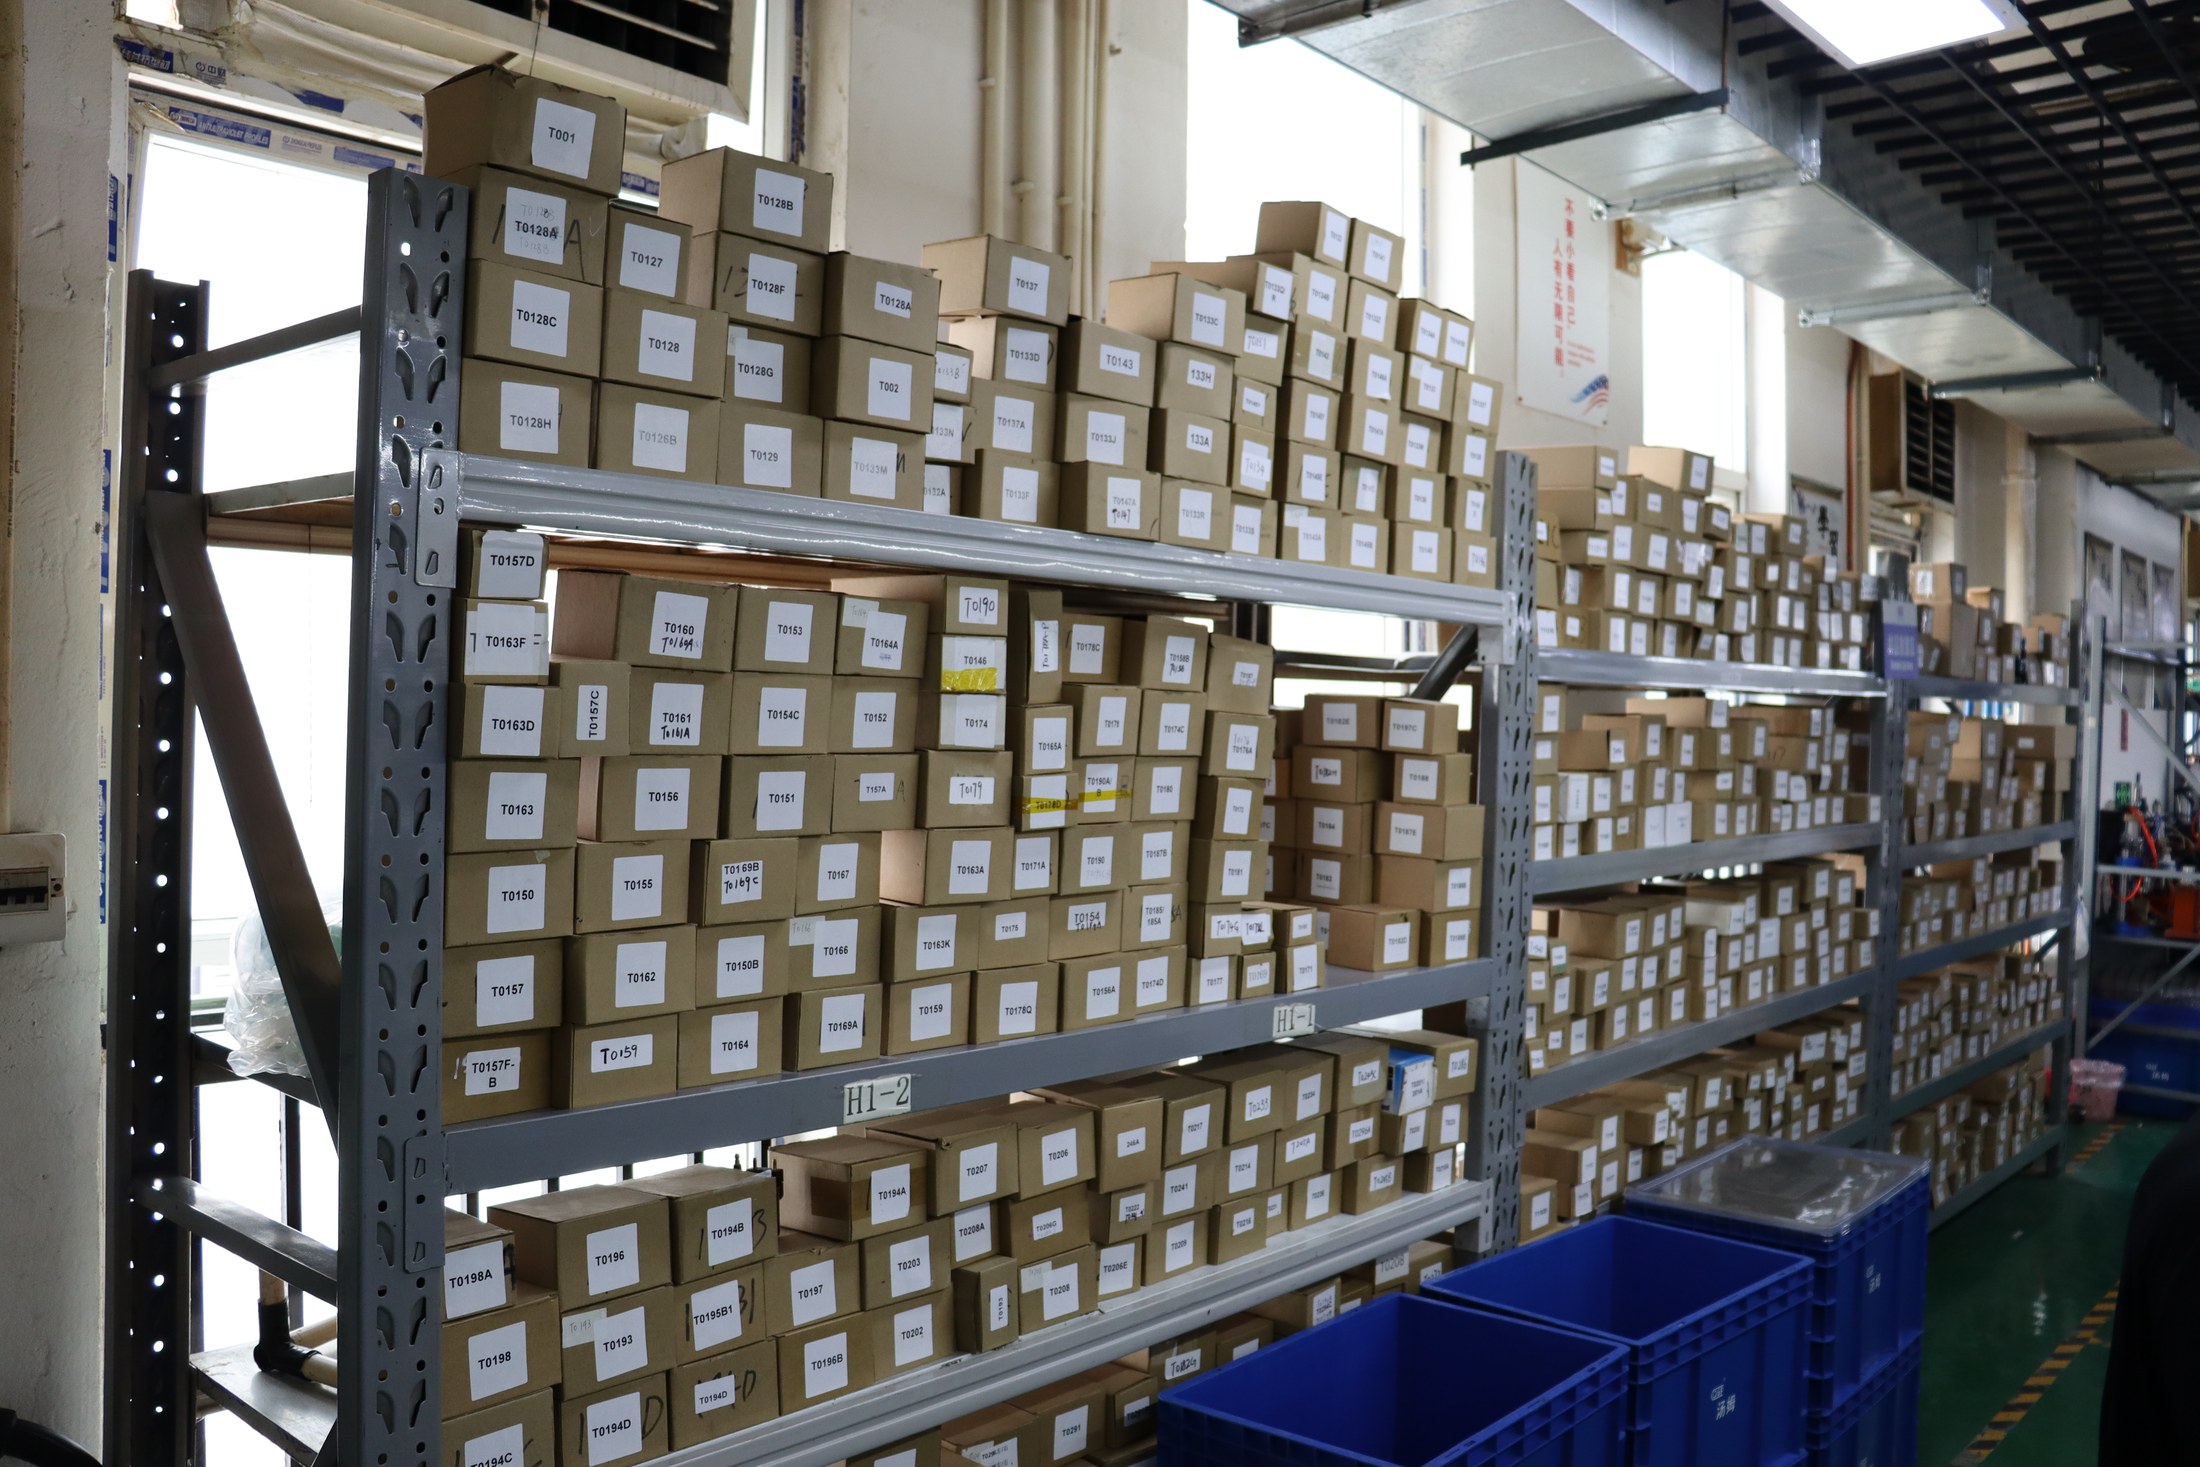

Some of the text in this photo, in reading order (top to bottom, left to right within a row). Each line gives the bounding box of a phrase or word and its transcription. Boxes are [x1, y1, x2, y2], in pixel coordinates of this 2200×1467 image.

[548, 127, 575, 144] T001
[758, 194, 793, 210] T0128B
[515, 221, 558, 239] T0128A
[632, 252, 663, 267] T0127
[752, 279, 785, 294] T0128F
[1016, 278, 1038, 290] T0137
[880, 294, 911, 310] T0128A
[516, 309, 556, 327] T0128C
[1196, 314, 1217, 325] T0133C
[648, 338, 679, 352] T0128
[1010, 350, 1039, 361] T0133D
[1108, 355, 1132, 369] T0143
[738, 363, 773, 377] T0128G
[880, 381, 898, 393] T002
[510, 415, 551, 429] T0128H
[998, 417, 1024, 428] T0137A
[639, 431, 677, 445] T0126B
[1191, 433, 1209, 447] 133A
[751, 450, 778, 462] T0129
[924, 487, 946, 496] 0132A
[491, 555, 534, 567] T0157D
[965, 597, 994, 617] T0190
[665, 622, 694, 635] T0160
[778, 624, 802, 635] T0153
[486, 636, 526, 648] T0163F
[871, 638, 898, 649] T0164A
[1077, 642, 1100, 651] T0178C
[964, 656, 986, 665] T0146
[589, 691, 599, 738] T0157C
[663, 713, 691, 723] T0161
[768, 710, 799, 720] T0154C
[864, 714, 887, 722] T0152
[492, 719, 534, 731] T0163D
[965, 718, 987, 728] T0174
[1039, 742, 1061, 750] T0165A
[649, 792, 678, 802] T0156
[769, 794, 794, 803] T0151
[1096, 789, 1101, 797] B
[501, 804, 533, 815] T0163
[724, 863, 759, 875] T0169B
[958, 866, 984, 874] T0163A
[1021, 862, 1046, 871] T0171A
[828, 870, 849, 880] T0167
[624, 879, 652, 890] T0155
[502, 890, 534, 902] T0150
[1075, 912, 1099, 922] T0154
[824, 945, 848, 956] T0166
[924, 940, 950, 950] T0163K
[726, 960, 759, 972] T0150B
[628, 972, 655, 983] T0162
[491, 984, 524, 997] T0157
[1092, 986, 1116, 996] T0156A
[919, 1004, 943, 1015] T0159
[1005, 1006, 1032, 1016] T0178Q
[1277, 1005, 1313, 1032] H1-1
[828, 1020, 858, 1032] T0169A
[722, 1040, 748, 1051] T0164
[600, 1044, 637, 1064] T0159
[472, 1060, 515, 1074] T0157F-
[489, 1077, 497, 1088] B
[847, 1077, 909, 1117] H1-2
[1048, 1149, 1068, 1160] T0206
[966, 1164, 988, 1176] T0207
[878, 1187, 906, 1200] T0194A
[1171, 1184, 1188, 1192] T0241
[712, 1223, 744, 1239] T0194B
[959, 1223, 984, 1236] T0208A
[595, 1250, 624, 1266] T0196
[898, 1258, 920, 1271] T0203
[1103, 1262, 1127, 1274] T0206E
[449, 1269, 492, 1288] T0198A
[798, 1284, 823, 1299] T0197
[1050, 1284, 1070, 1296] T0208
[694, 1305, 732, 1325] T0195B1
[901, 1327, 924, 1340] T0202
[603, 1335, 633, 1352] T0193
[478, 1351, 511, 1370] T0198
[811, 1354, 843, 1371] T0196B
[700, 1391, 727, 1404] T0194D
[592, 1419, 631, 1438] T0194D
[1062, 1424, 1080, 1436] T0291
[470, 1453, 512, 1467] 0194C
